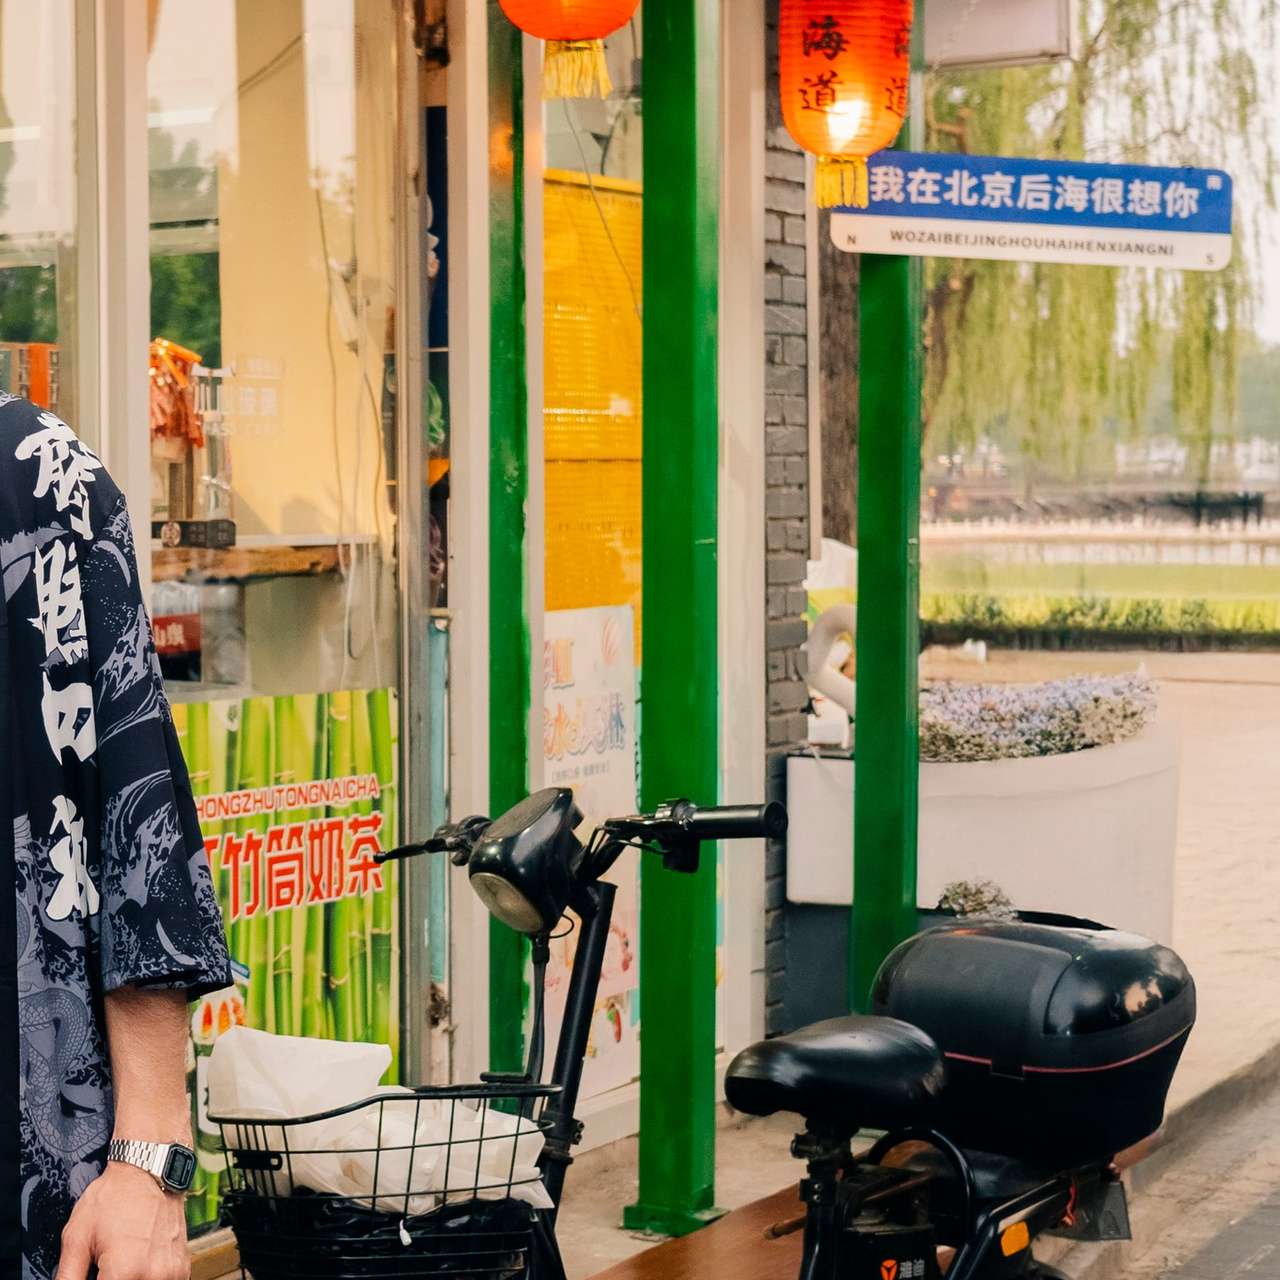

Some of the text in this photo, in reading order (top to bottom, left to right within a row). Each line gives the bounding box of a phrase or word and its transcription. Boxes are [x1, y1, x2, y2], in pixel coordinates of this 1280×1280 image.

[870, 164, 1200, 218] 我在北京后海很想你
[847, 234, 857, 246] N
[890, 229, 1175, 257] WOZAIBEIJINGHOUHAIHENXIANGNI
